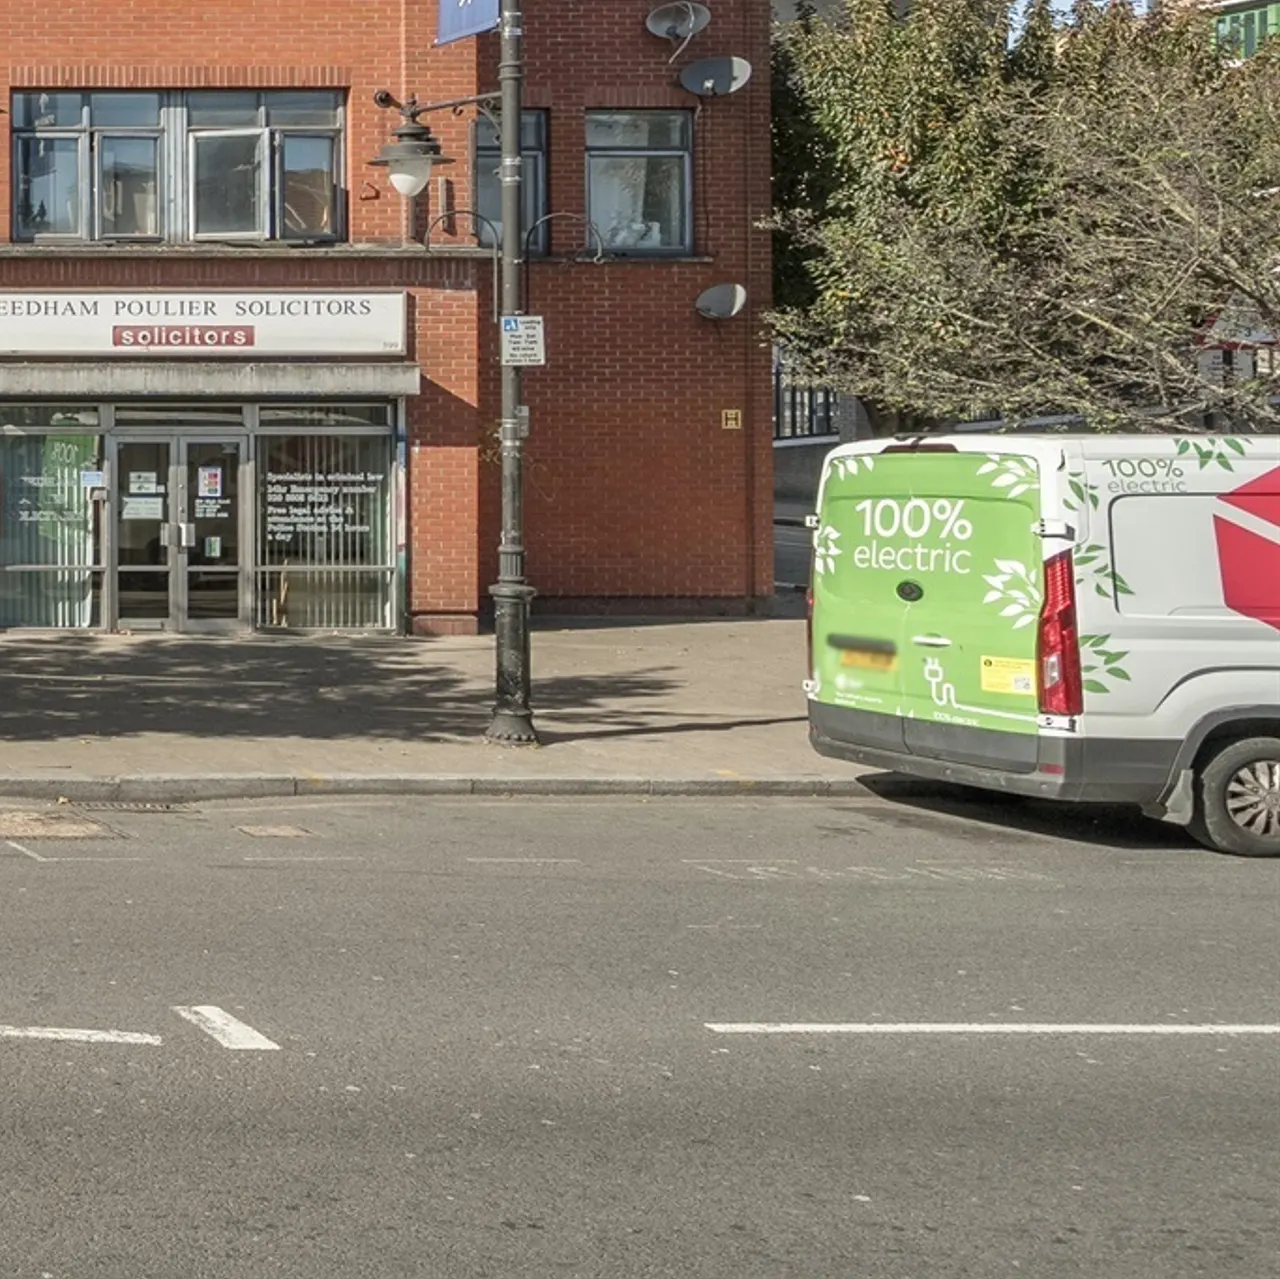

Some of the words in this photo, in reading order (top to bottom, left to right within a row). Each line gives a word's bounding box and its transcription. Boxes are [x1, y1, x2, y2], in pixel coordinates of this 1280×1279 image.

[114, 300, 217, 317] POULIER
[235, 300, 372, 317] SOLICITORS
[121, 326, 246, 345] solicitors
[1102, 458, 1185, 479] 100%
[1106, 477, 1188, 495] electric
[854, 498, 973, 540] 100%
[853, 541, 972, 574] electric
